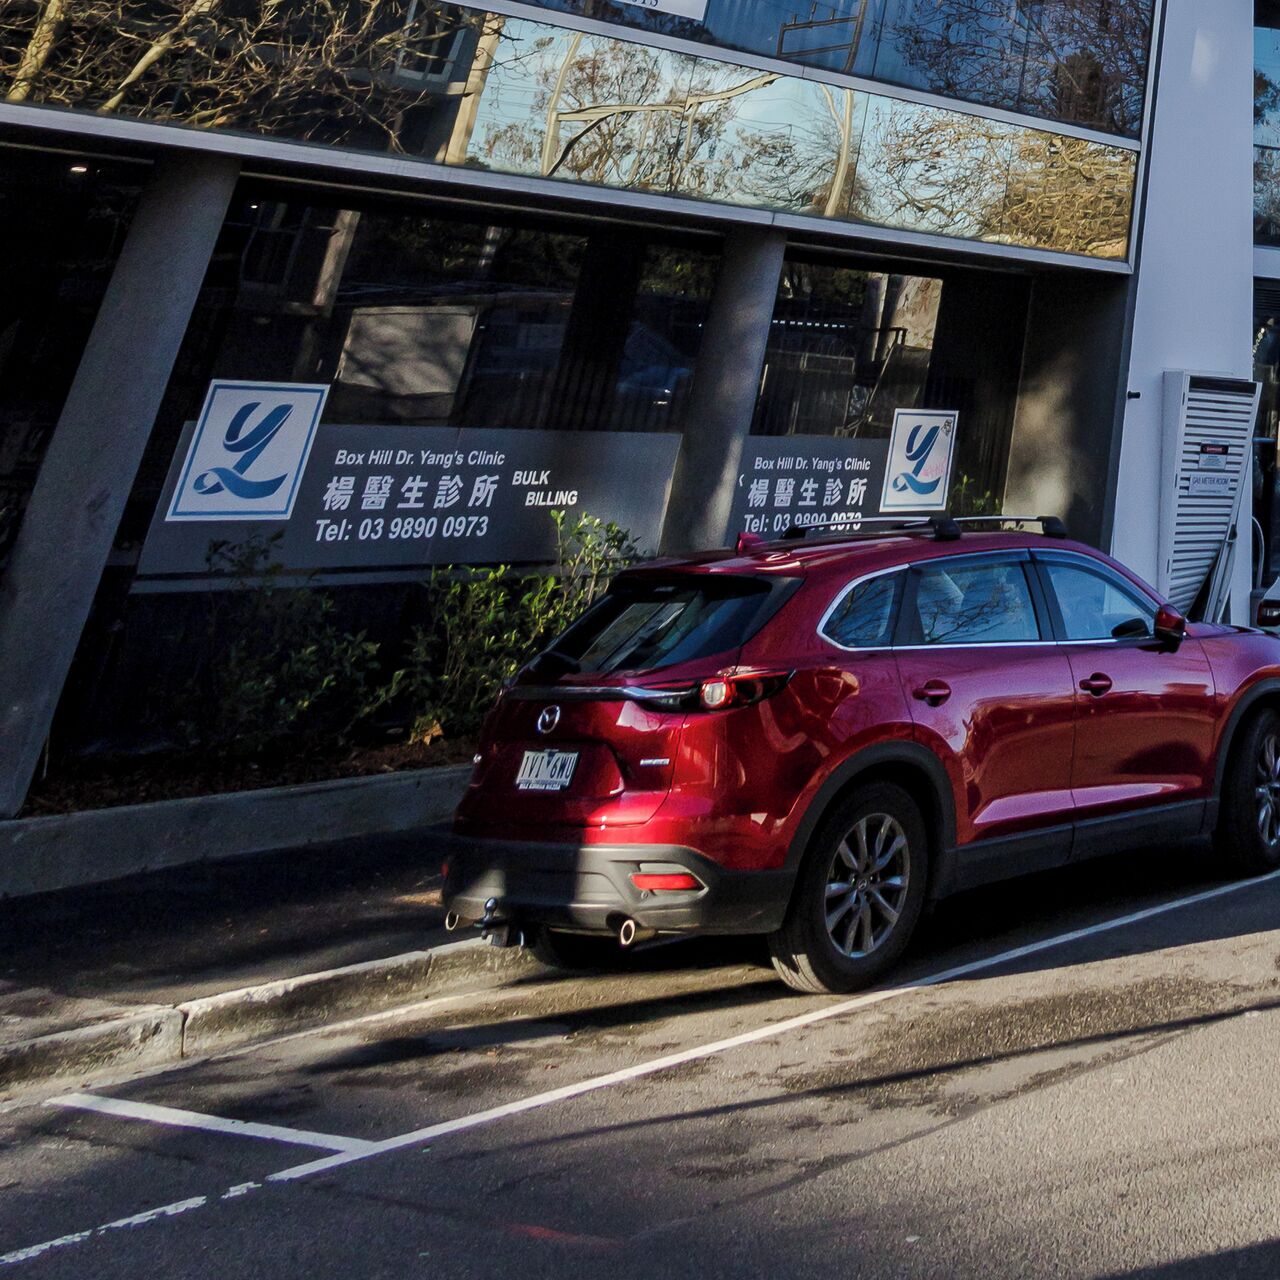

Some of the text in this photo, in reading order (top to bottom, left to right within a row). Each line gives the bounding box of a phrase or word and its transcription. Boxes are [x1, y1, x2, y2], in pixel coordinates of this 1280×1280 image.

[334, 449, 506, 469] Box Hill Dr. Yang's Clinic
[754, 457, 871, 473] Box Hill Dr. Yang's Clinic
[512, 470, 551, 486] BULK
[322, 474, 500, 511] 楊醫生診所
[524, 490, 578, 507] BILLING
[747, 478, 868, 508] 楊醫生診所
[315, 516, 490, 542] Tel: 03 9890 0973
[744, 514, 769, 533] Tel:
[773, 513, 791, 532] 03
